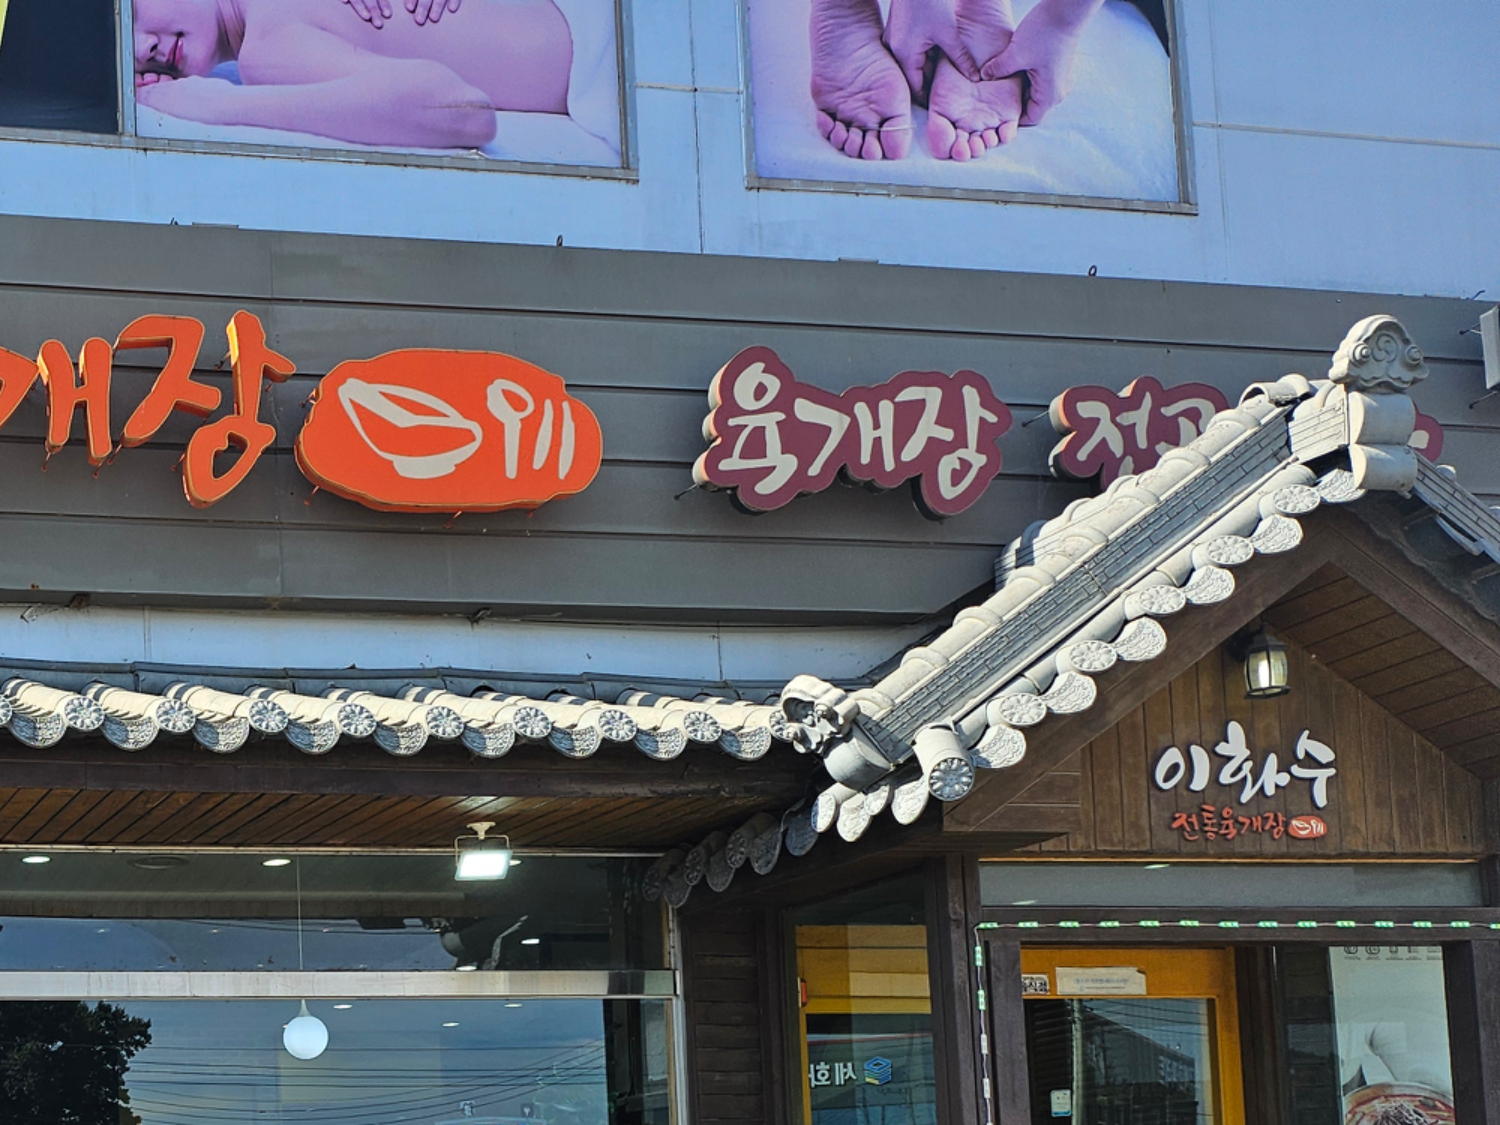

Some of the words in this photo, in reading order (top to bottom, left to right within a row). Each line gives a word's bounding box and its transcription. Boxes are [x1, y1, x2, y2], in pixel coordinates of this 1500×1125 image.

[718, 362, 998, 500] 육개장
[1155, 721, 1337, 808] 이화수
[1171, 804, 1286, 840] 전통육개장
